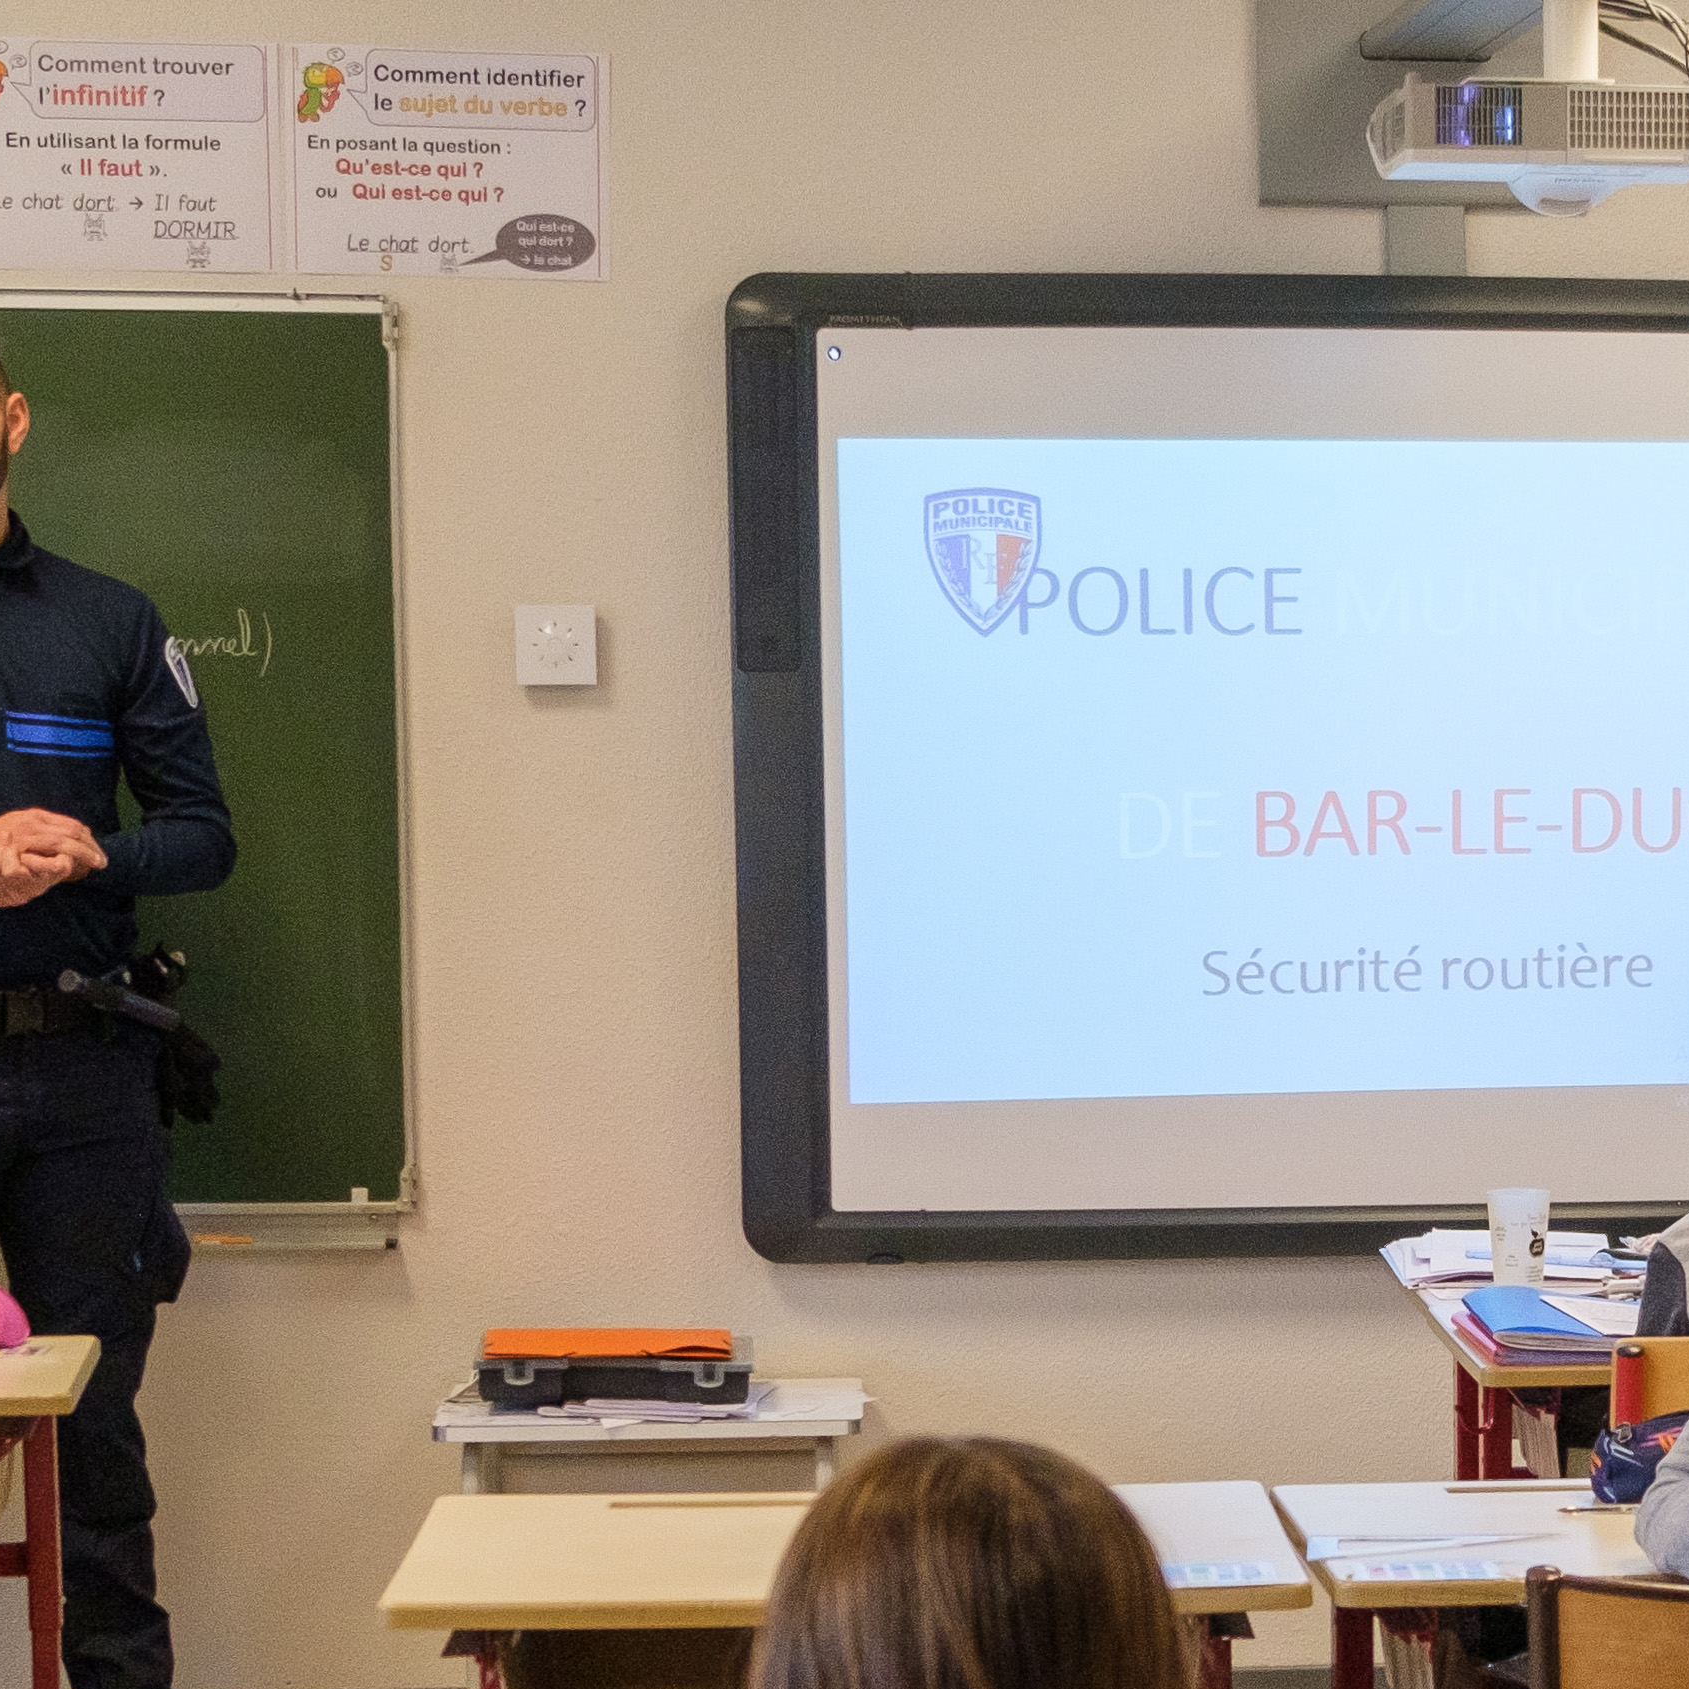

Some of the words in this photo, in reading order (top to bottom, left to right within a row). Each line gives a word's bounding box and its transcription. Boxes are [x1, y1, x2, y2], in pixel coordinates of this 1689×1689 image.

[37, 54, 148, 74] Comment
[152, 59, 235, 76] trouver
[373, 64, 481, 86] Comment
[486, 67, 585, 88] identifier
[38, 84, 149, 107] l'infinitif
[373, 93, 393, 112] le
[398, 95, 458, 118] sujet
[463, 95, 493, 115] du
[499, 97, 568, 117] verbe
[5, 132, 31, 149] En
[36, 132, 117, 151] utilisant
[121, 133, 140, 151] la
[144, 134, 222, 152] formule
[307, 134, 331, 150] En
[335, 136, 398, 154] posant
[402, 137, 418, 152] la
[423, 139, 501, 157] question
[79, 158, 92, 176] Il
[97, 157, 144, 178] faut
[335, 158, 432, 177] Qu'est-ce
[436, 161, 467, 180] qui
[22, 192, 63, 210] chat
[154, 193, 170, 212] Il
[178, 194, 217, 213] faut
[315, 186, 338, 199] ou
[351, 183, 386, 201] Qui
[391, 185, 452, 202] est-ce
[457, 187, 488, 206] qui
[153, 219, 238, 240] DORMIR
[347, 233, 370, 252] Le
[378, 234, 419, 252] chat
[380, 254, 393, 272] S
[932, 497, 1033, 520] POLICE
[932, 515, 1033, 533] MUNICIPALE
[1018, 565, 1303, 636] POLICE
[1201, 944, 1422, 997] Sécurité
[1441, 942, 1654, 991] routière
